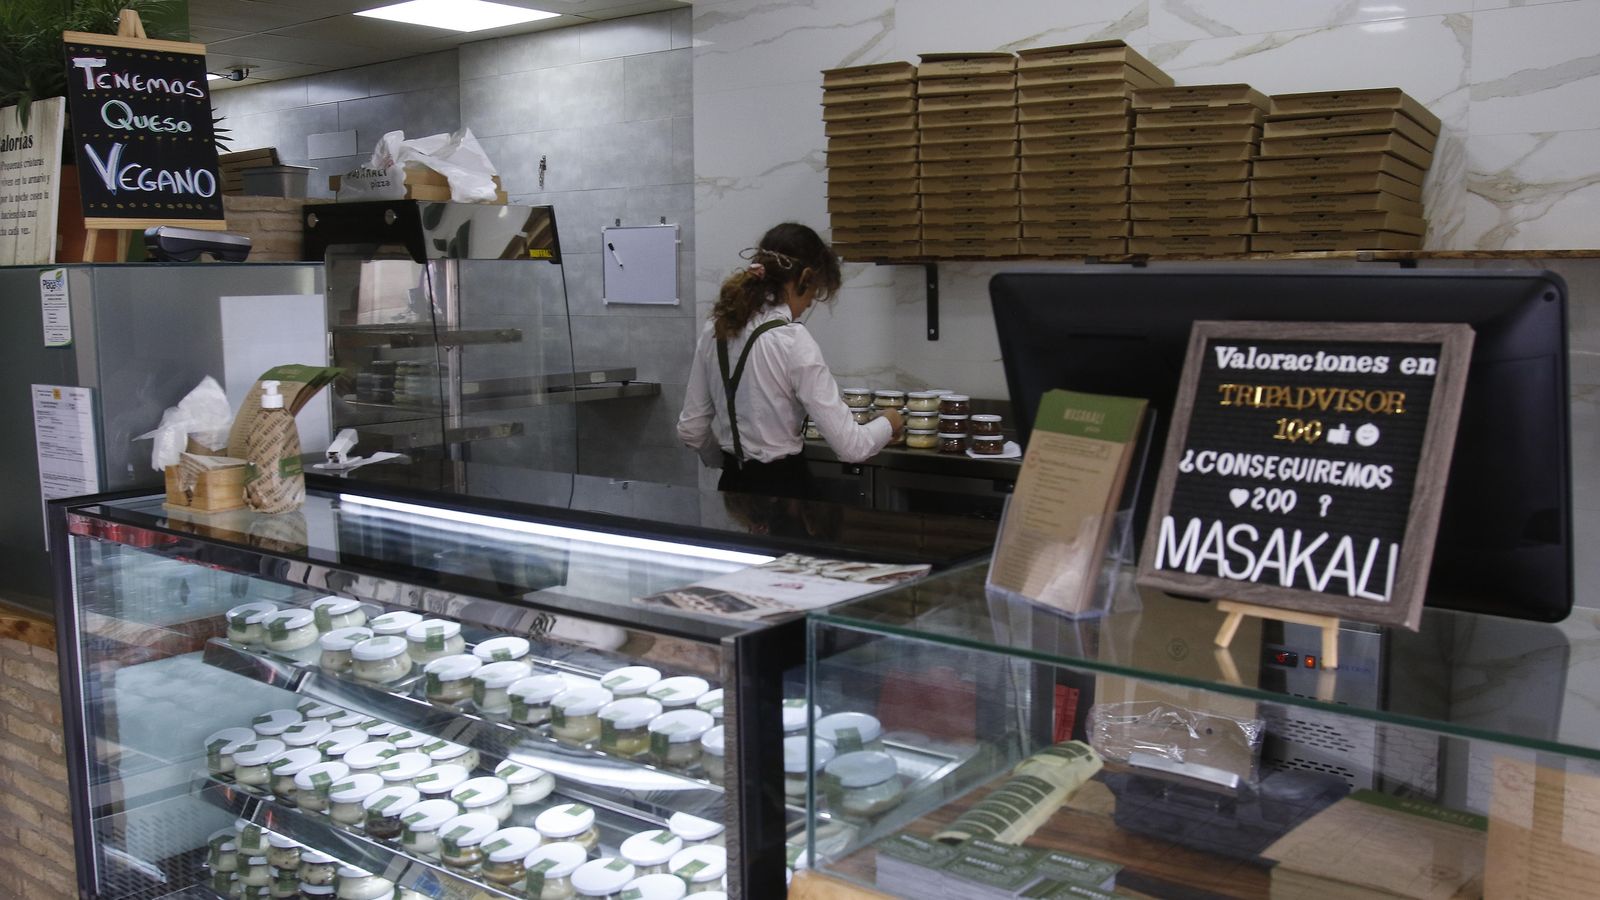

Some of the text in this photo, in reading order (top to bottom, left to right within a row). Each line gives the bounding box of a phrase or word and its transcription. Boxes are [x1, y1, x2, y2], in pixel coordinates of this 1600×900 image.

[72, 57, 205, 98] TENEMOS
[101, 99, 192, 133] QUESO
[0, 130, 34, 152] alorías
[85, 142, 217, 198] VEGANO
[1214, 345, 1438, 376] Valoraciones en
[1218, 382, 1408, 415] TRIPADVISOR
[1272, 417, 1323, 445] 100
[1178, 448, 1394, 490] ¿CONSEGUIREMOS
[1251, 487, 1333, 517] 200 ?
[1154, 514, 1400, 603] MASAKALI
